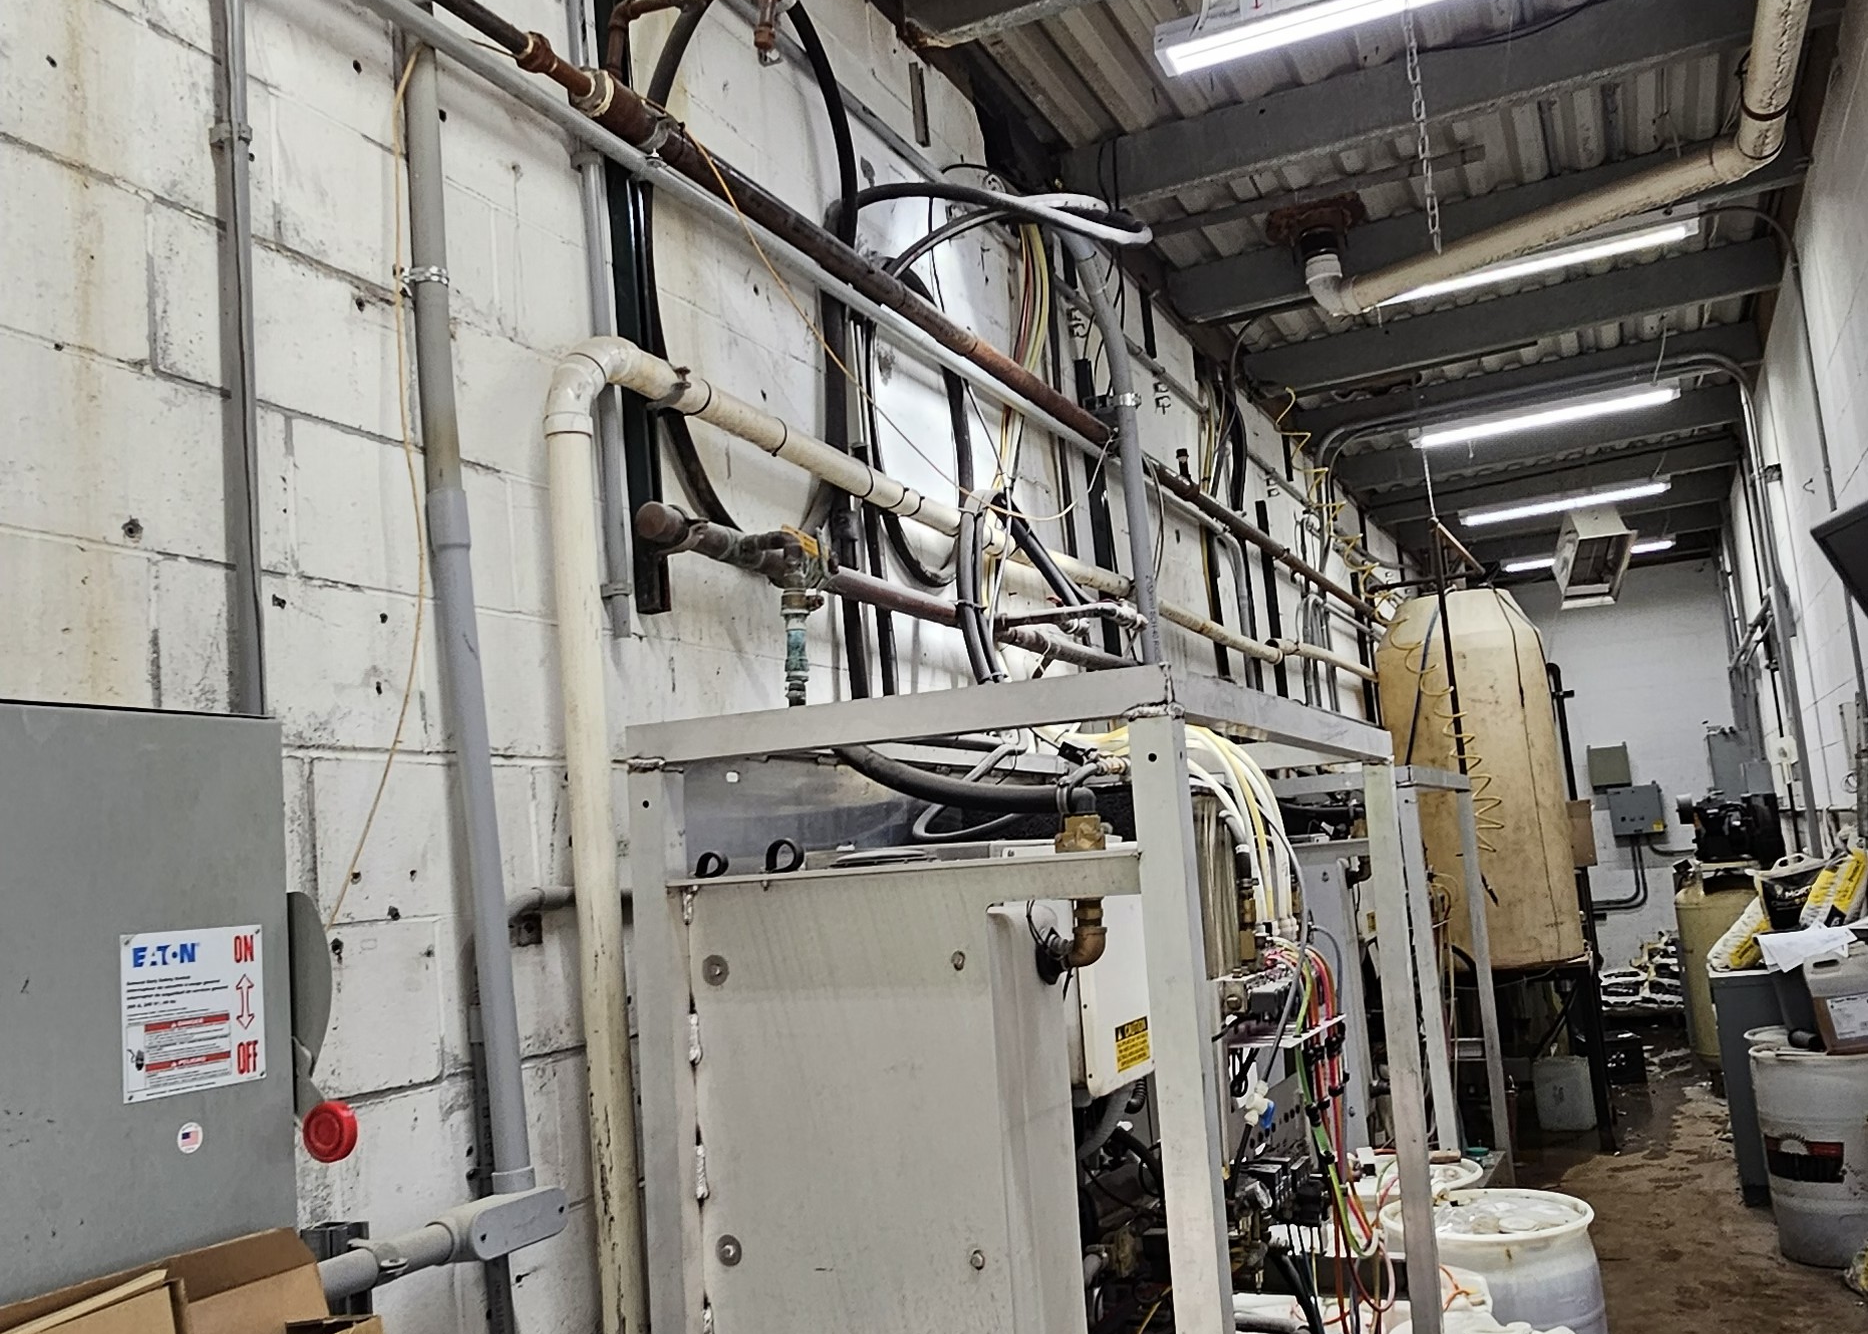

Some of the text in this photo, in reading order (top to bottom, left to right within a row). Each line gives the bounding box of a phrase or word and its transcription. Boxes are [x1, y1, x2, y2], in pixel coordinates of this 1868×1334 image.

[133, 942, 197, 967] EATON
[234, 934, 254, 964] ON
[237, 1040, 258, 1075] OFF
